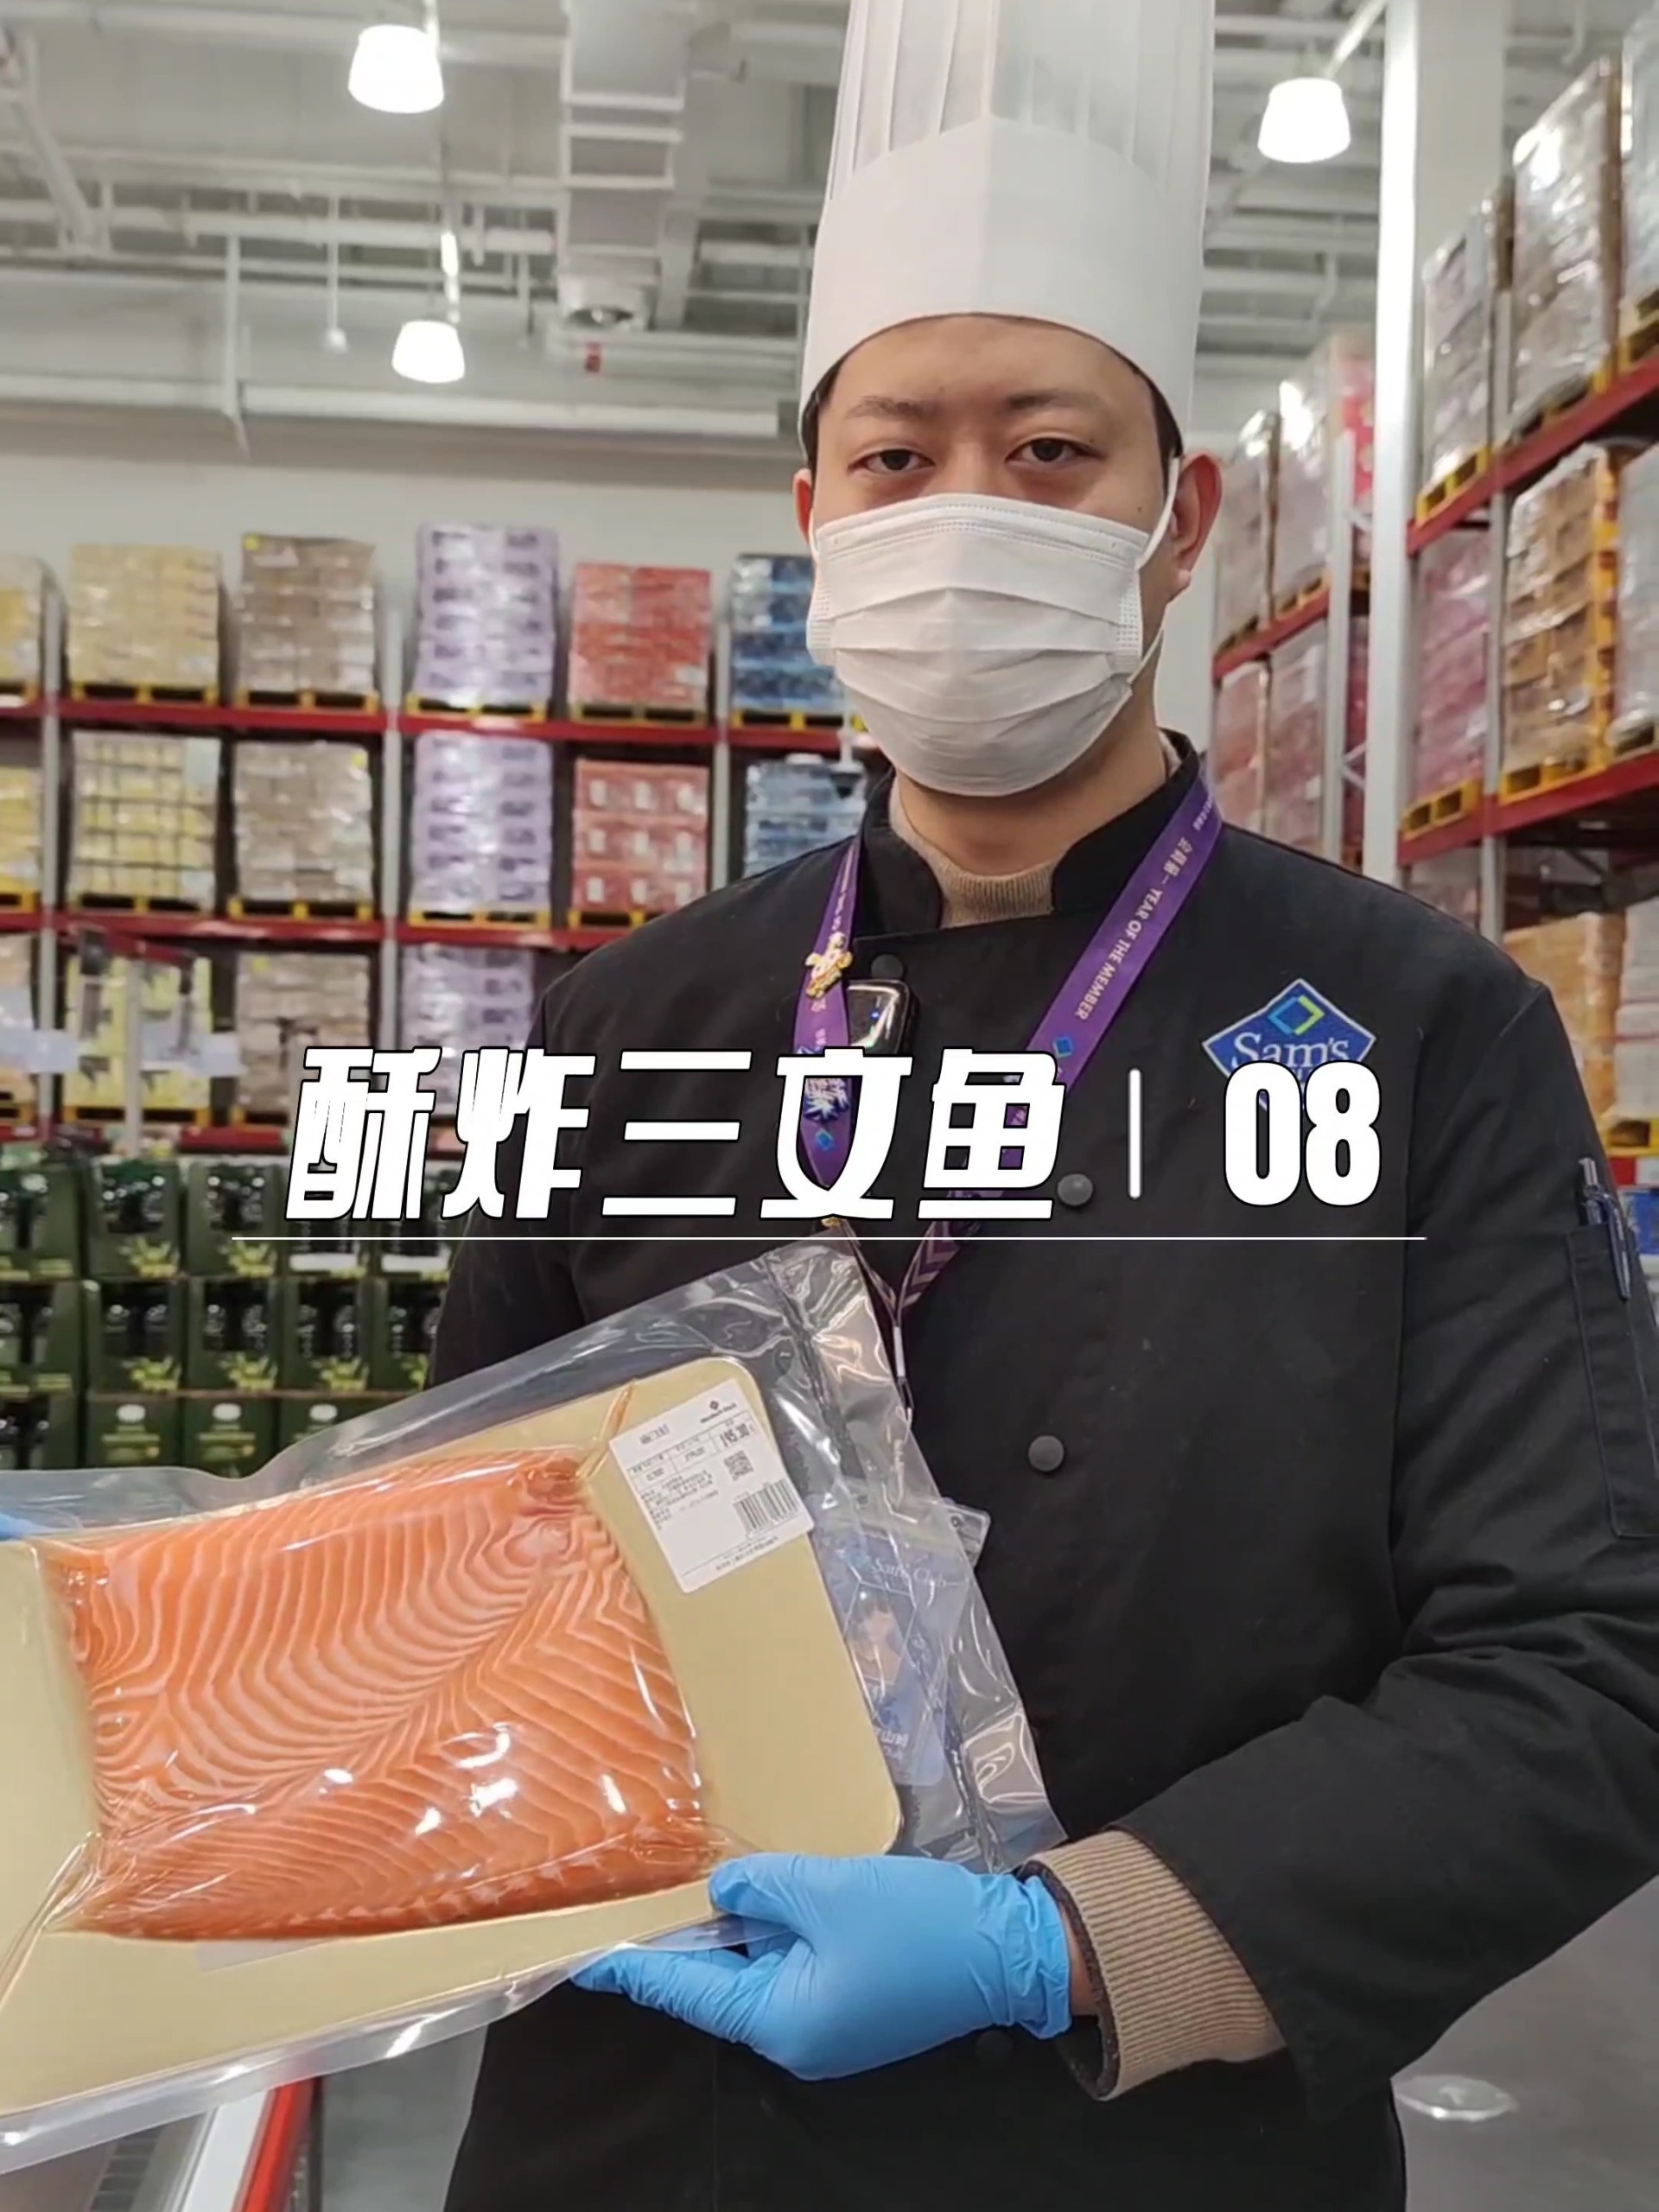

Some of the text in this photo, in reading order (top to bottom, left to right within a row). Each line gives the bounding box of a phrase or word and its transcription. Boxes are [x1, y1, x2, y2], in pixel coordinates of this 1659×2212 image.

[1075, 888, 1163, 1020] YEAR OF THE MEMBER
[1231, 1032, 1349, 1068] Sam's
